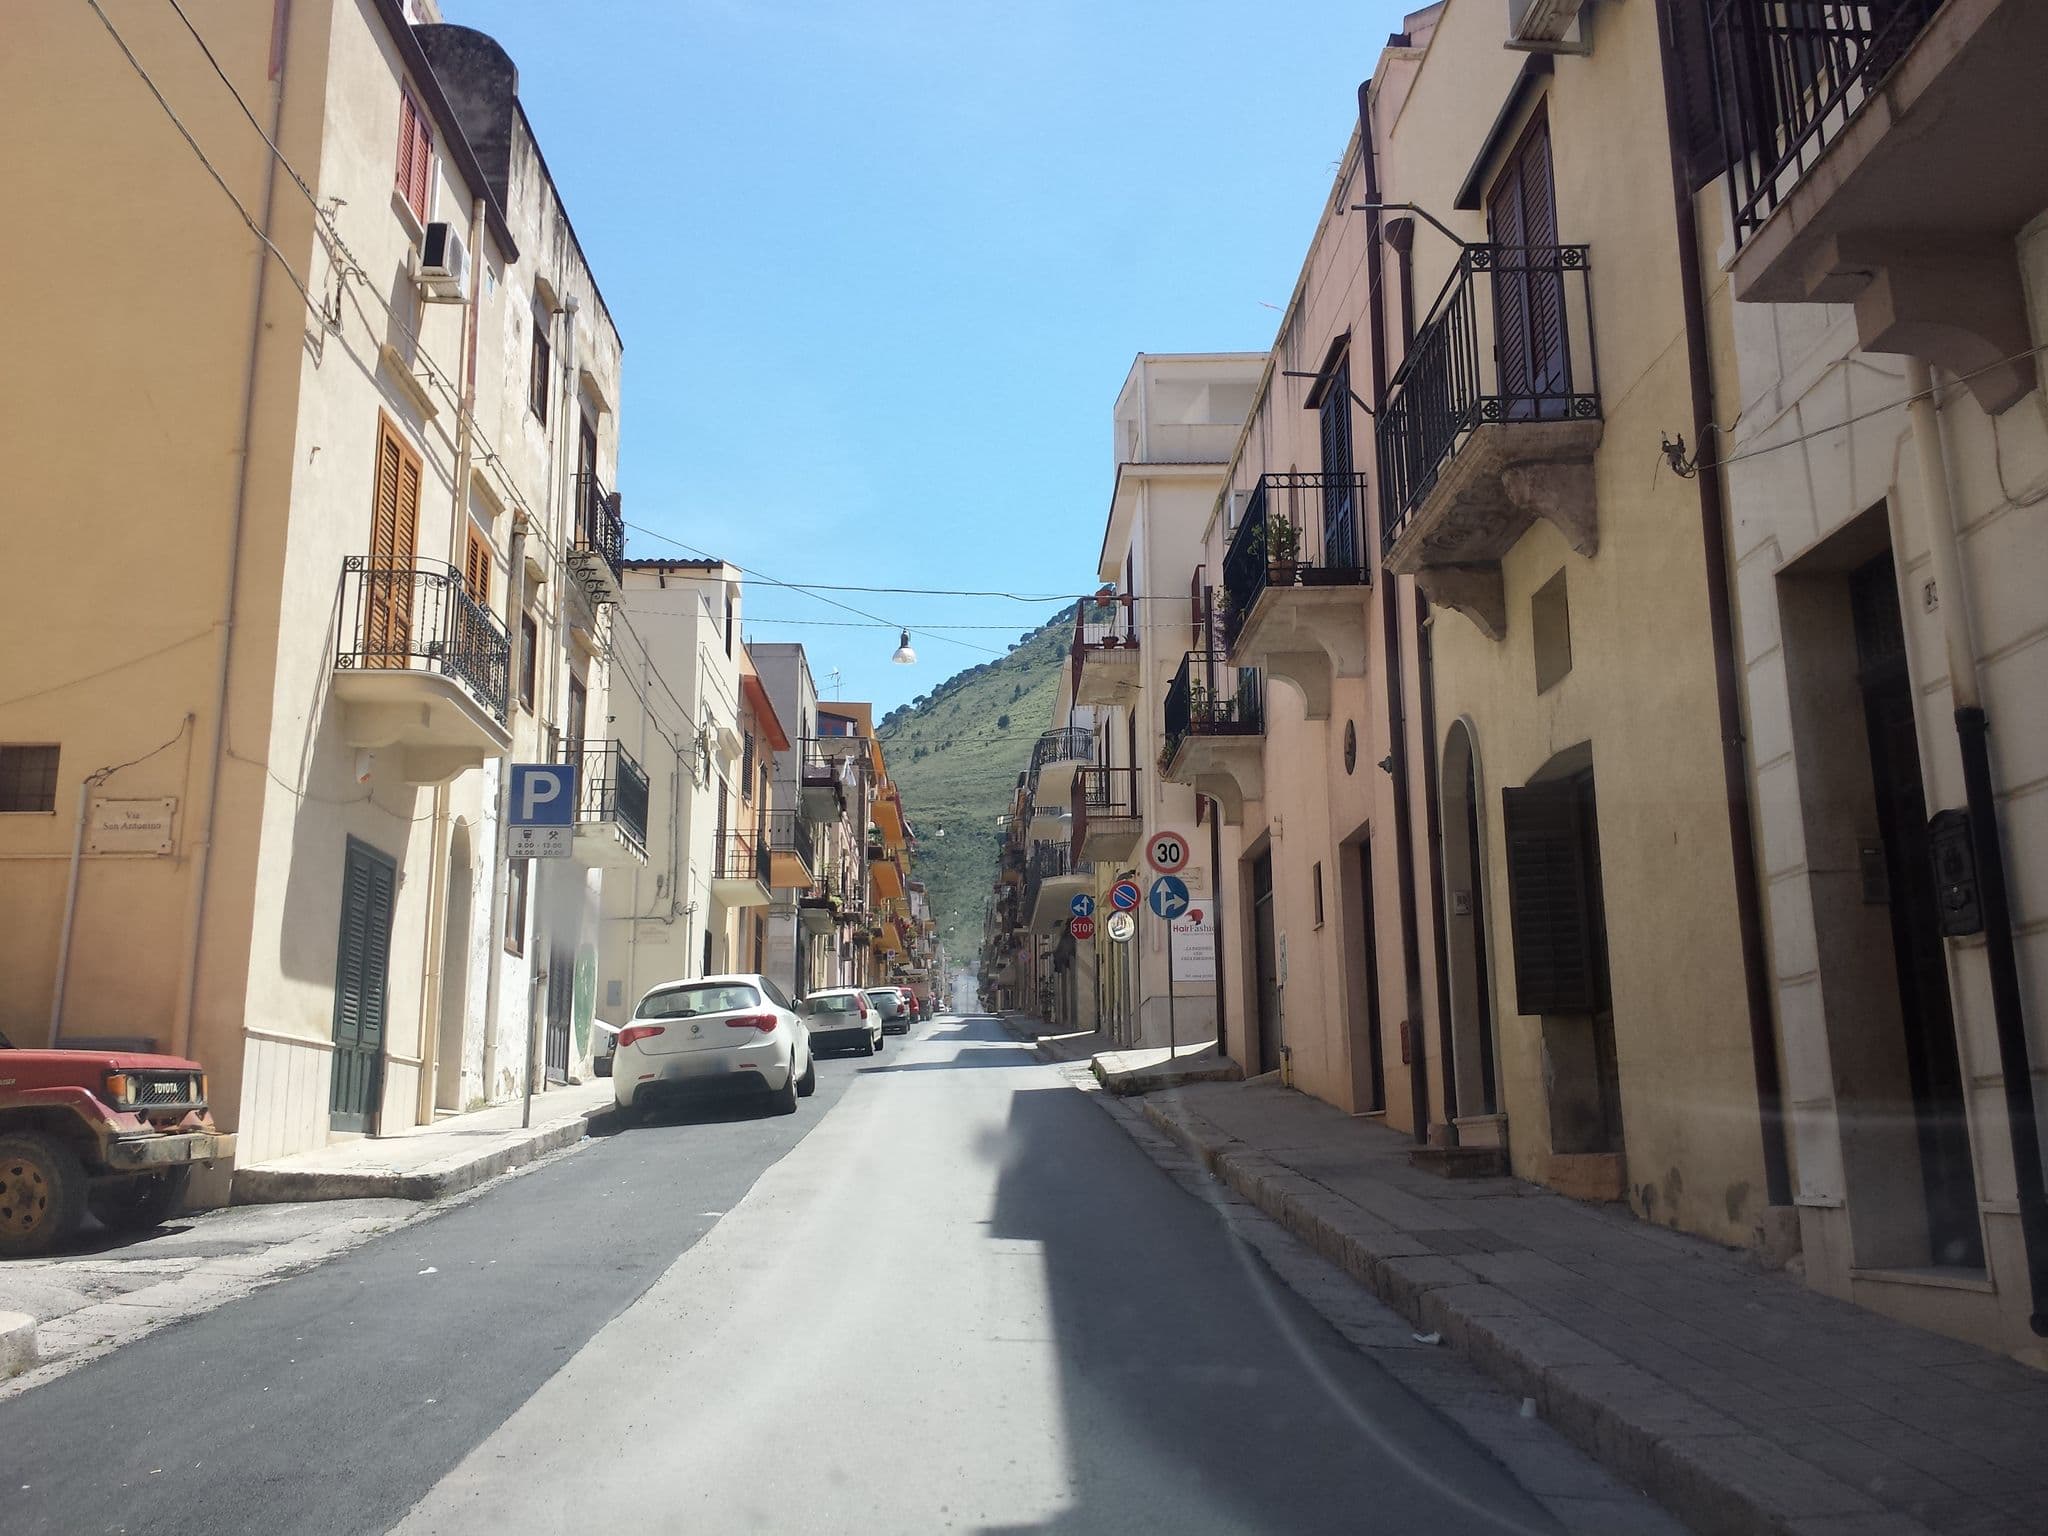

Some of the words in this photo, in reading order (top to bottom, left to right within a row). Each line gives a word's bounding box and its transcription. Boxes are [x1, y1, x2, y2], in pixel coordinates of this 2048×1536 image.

[522, 771, 561, 820] P
[126, 811, 141, 820] Via
[103, 822, 120, 831] San
[1157, 843, 1180, 863] 30
[1072, 923, 1094, 932] STOP
[154, 1083, 178, 1093] TOYOTA
